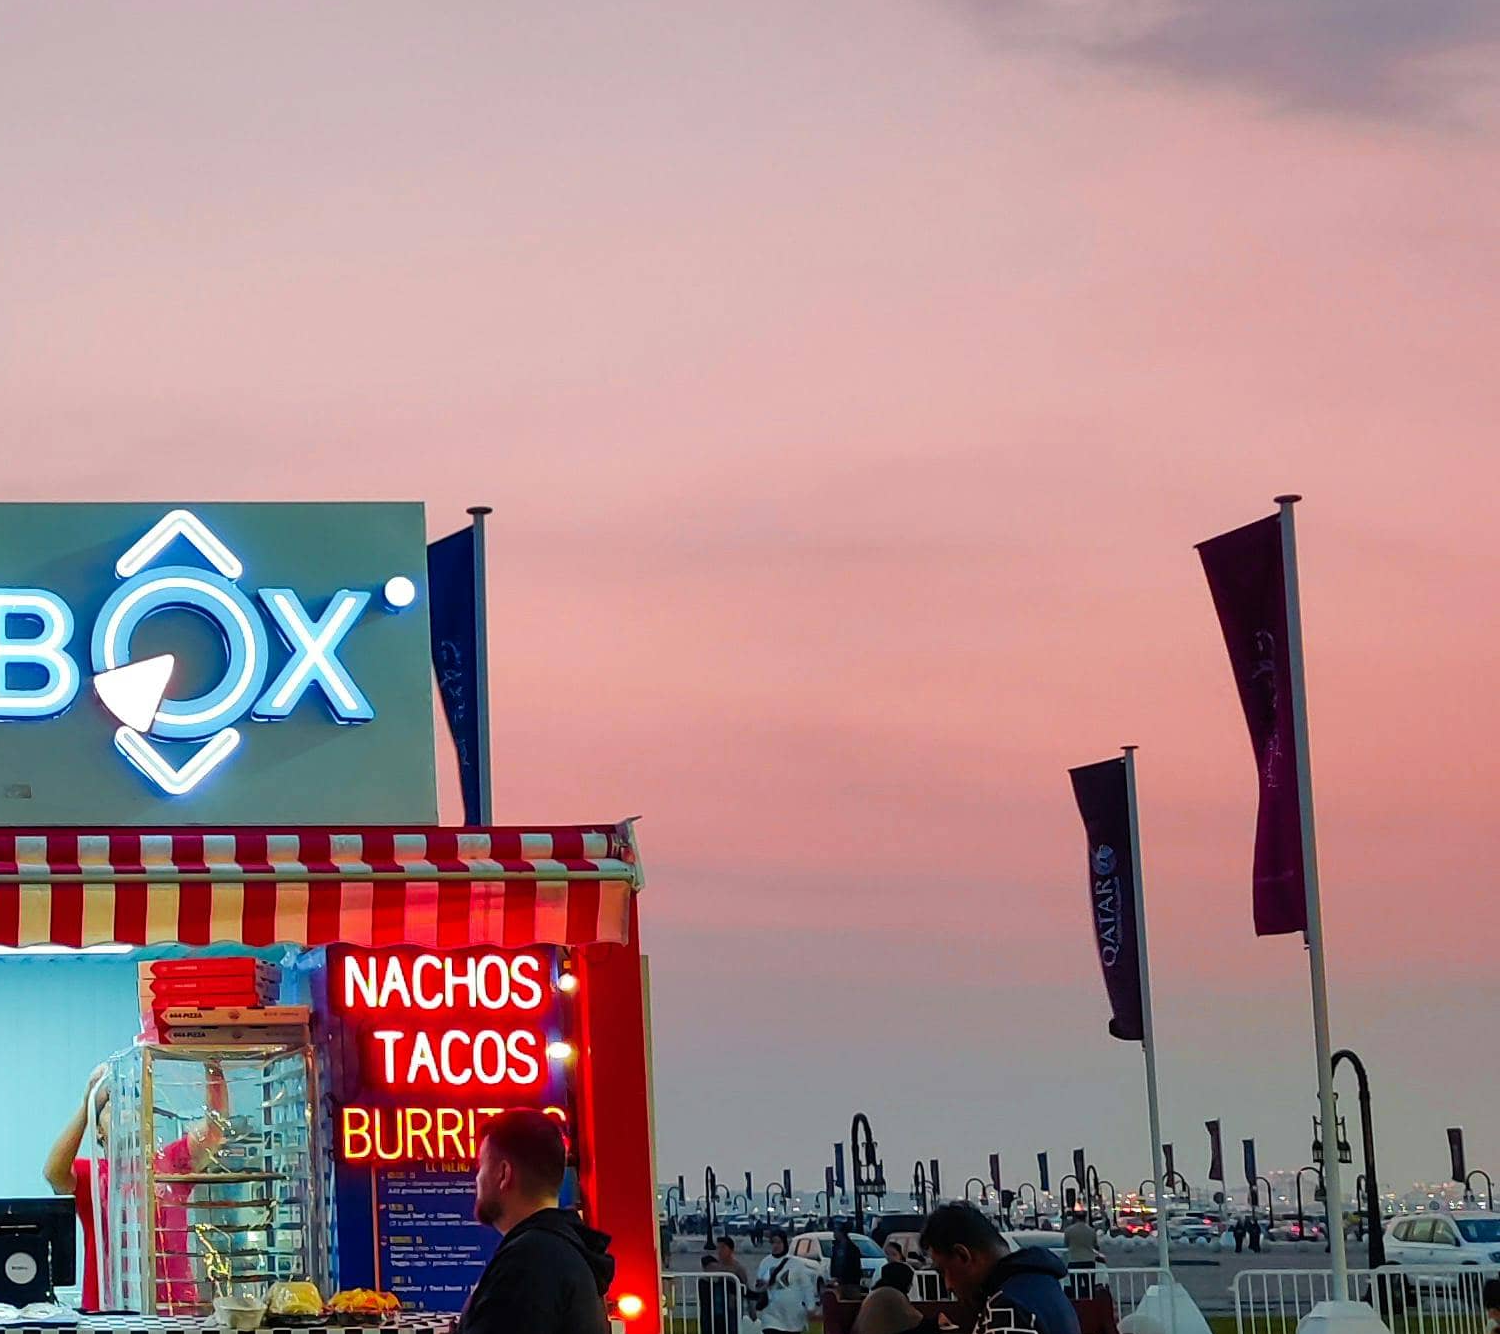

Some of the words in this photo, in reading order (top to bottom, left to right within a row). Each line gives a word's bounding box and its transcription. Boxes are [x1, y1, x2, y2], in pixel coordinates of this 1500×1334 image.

[1095, 878, 1119, 967] QATAR
[344, 954, 542, 1009] NACHOS
[373, 1029, 539, 1085] TACOS
[343, 1106, 566, 1159] BURRI
